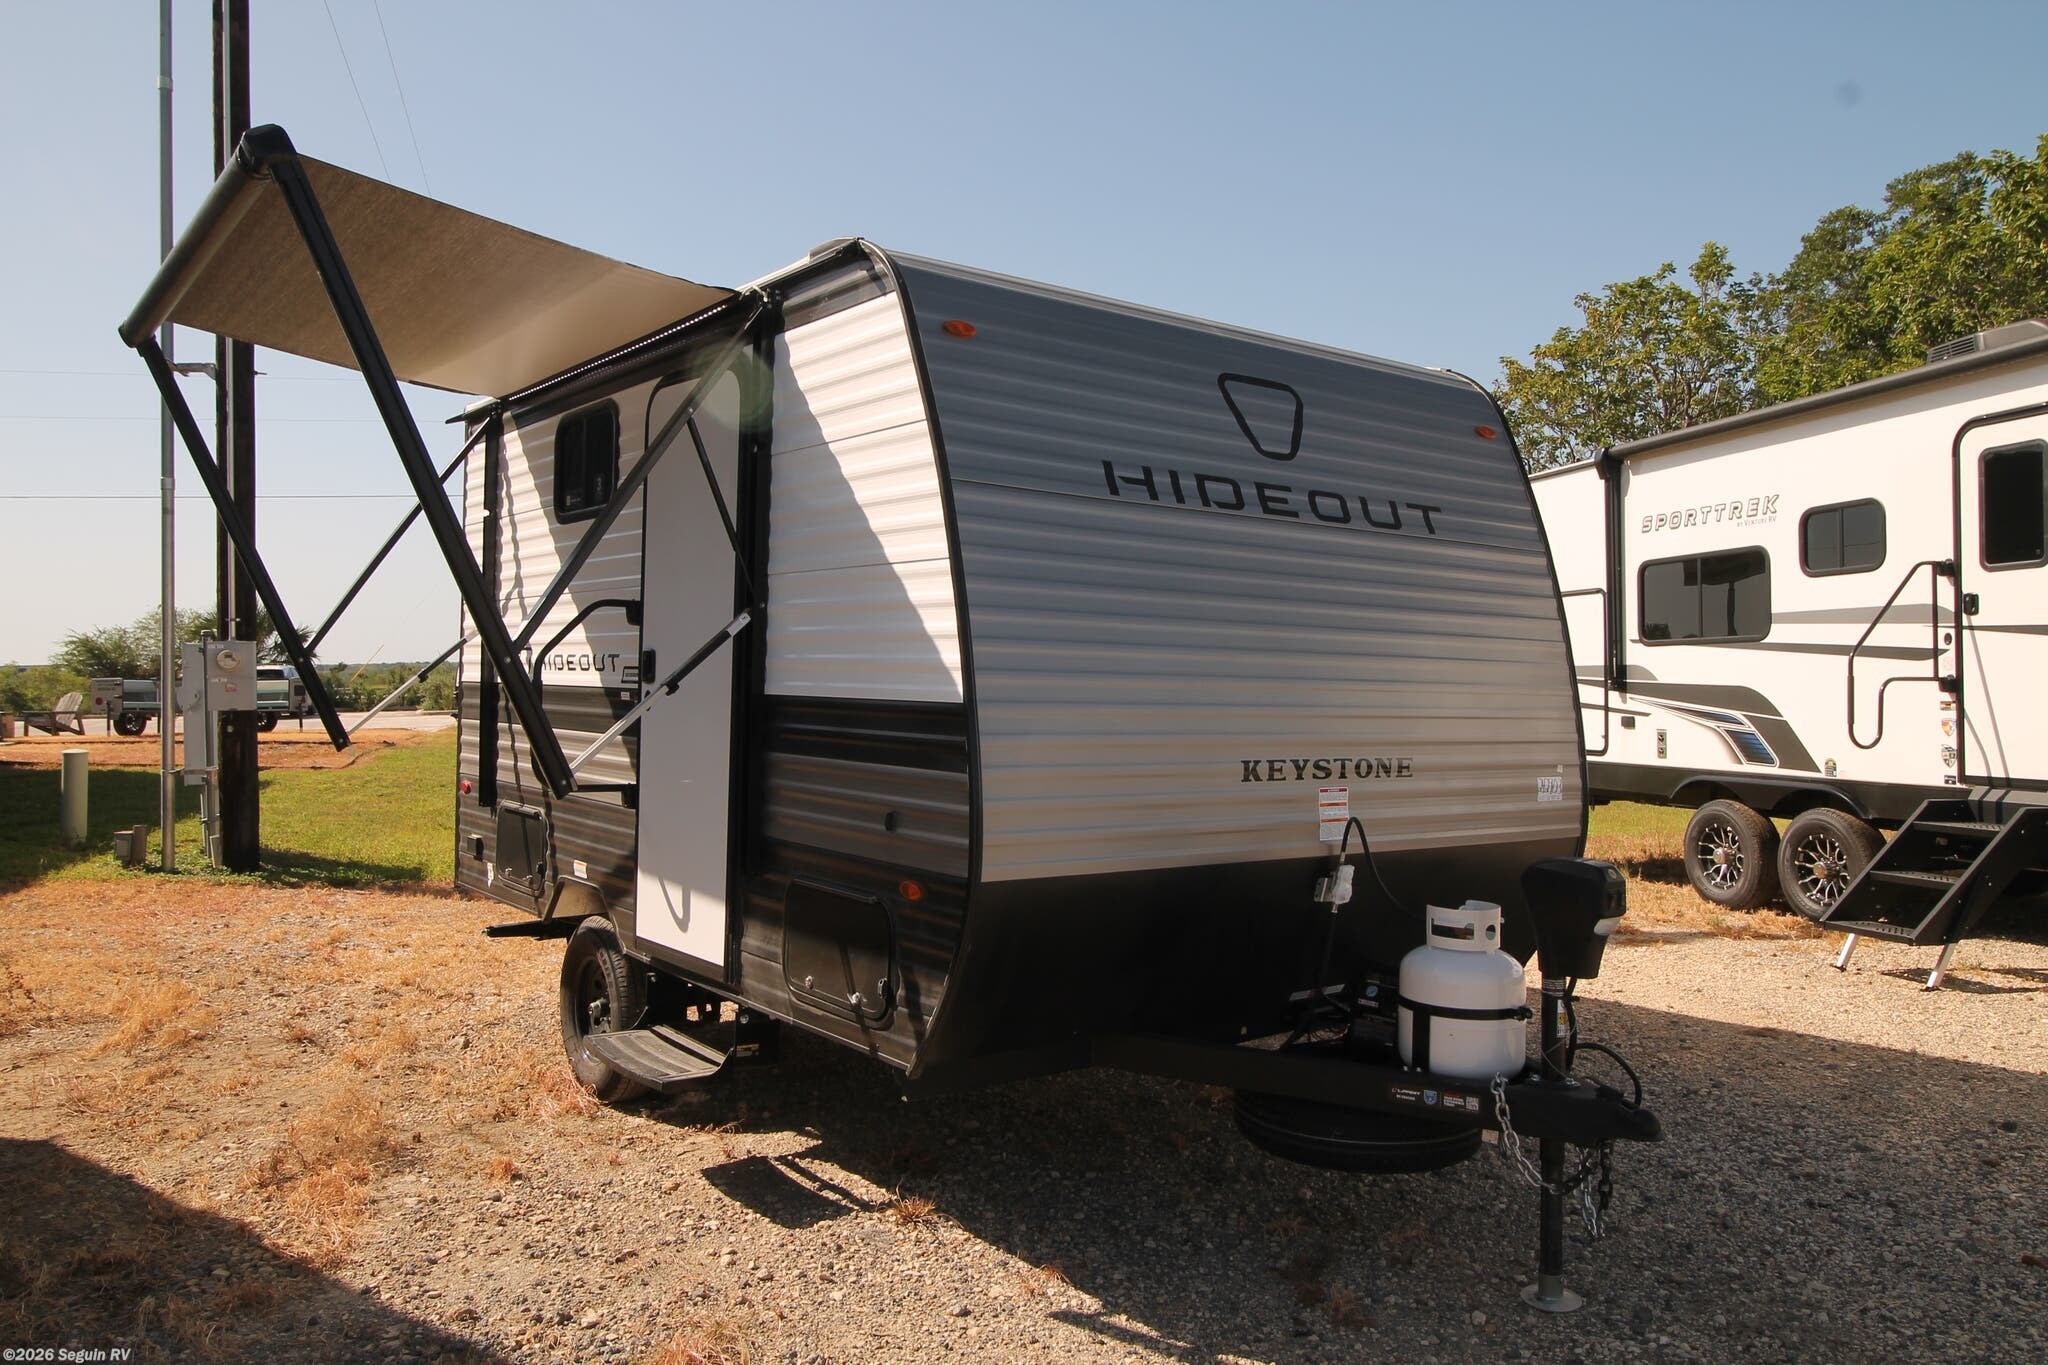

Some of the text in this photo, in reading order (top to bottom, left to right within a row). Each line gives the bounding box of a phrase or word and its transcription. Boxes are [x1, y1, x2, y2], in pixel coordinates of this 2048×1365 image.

[1101, 459, 1442, 534] HIDEOUT
[1642, 494, 1780, 533] SPORTTREK
[1241, 757, 1414, 782] KEYSTONE
